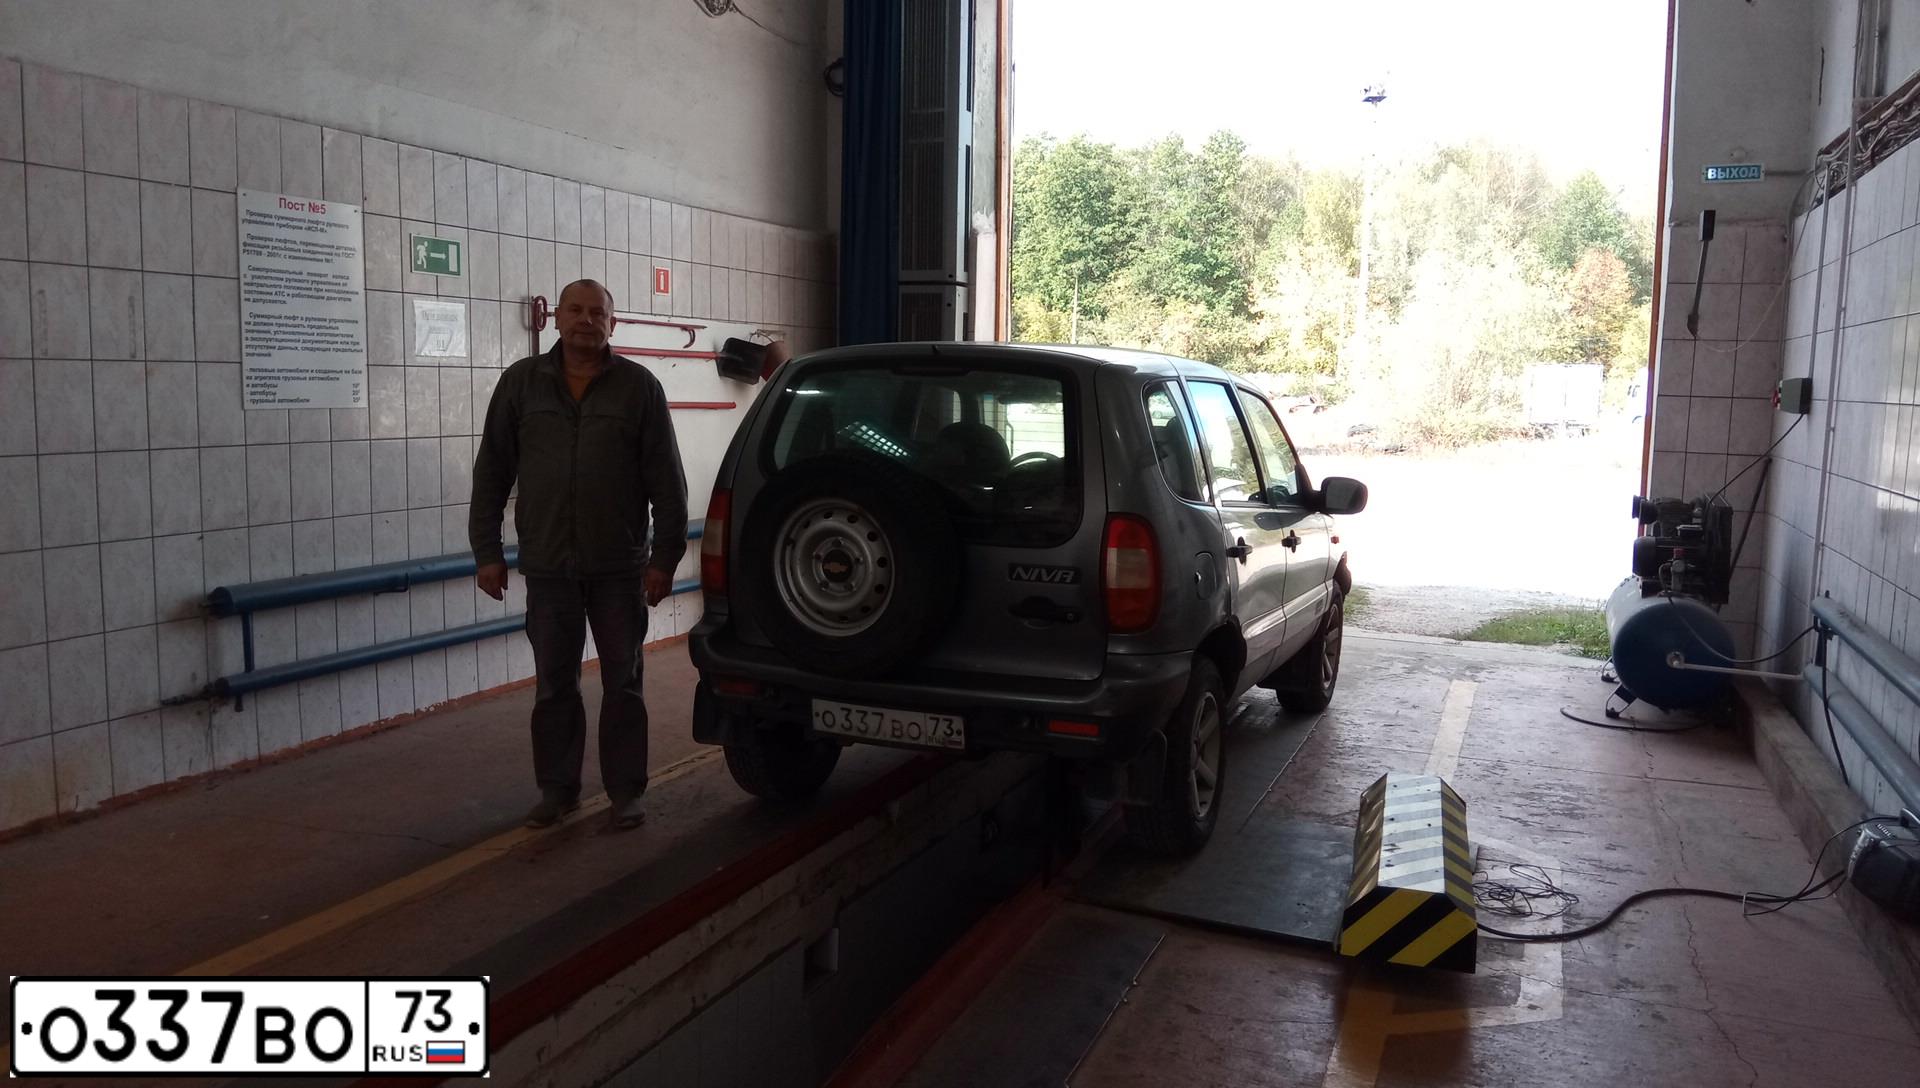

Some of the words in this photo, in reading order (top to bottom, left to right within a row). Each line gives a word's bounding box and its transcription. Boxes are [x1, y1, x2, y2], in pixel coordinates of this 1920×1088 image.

[1707, 167, 1759, 179] ВЫХОД
[279, 197, 305, 212] Пост
[308, 202, 327, 214] №5
[1011, 566, 1075, 583] NIVA
[928, 716, 954, 737] 73
